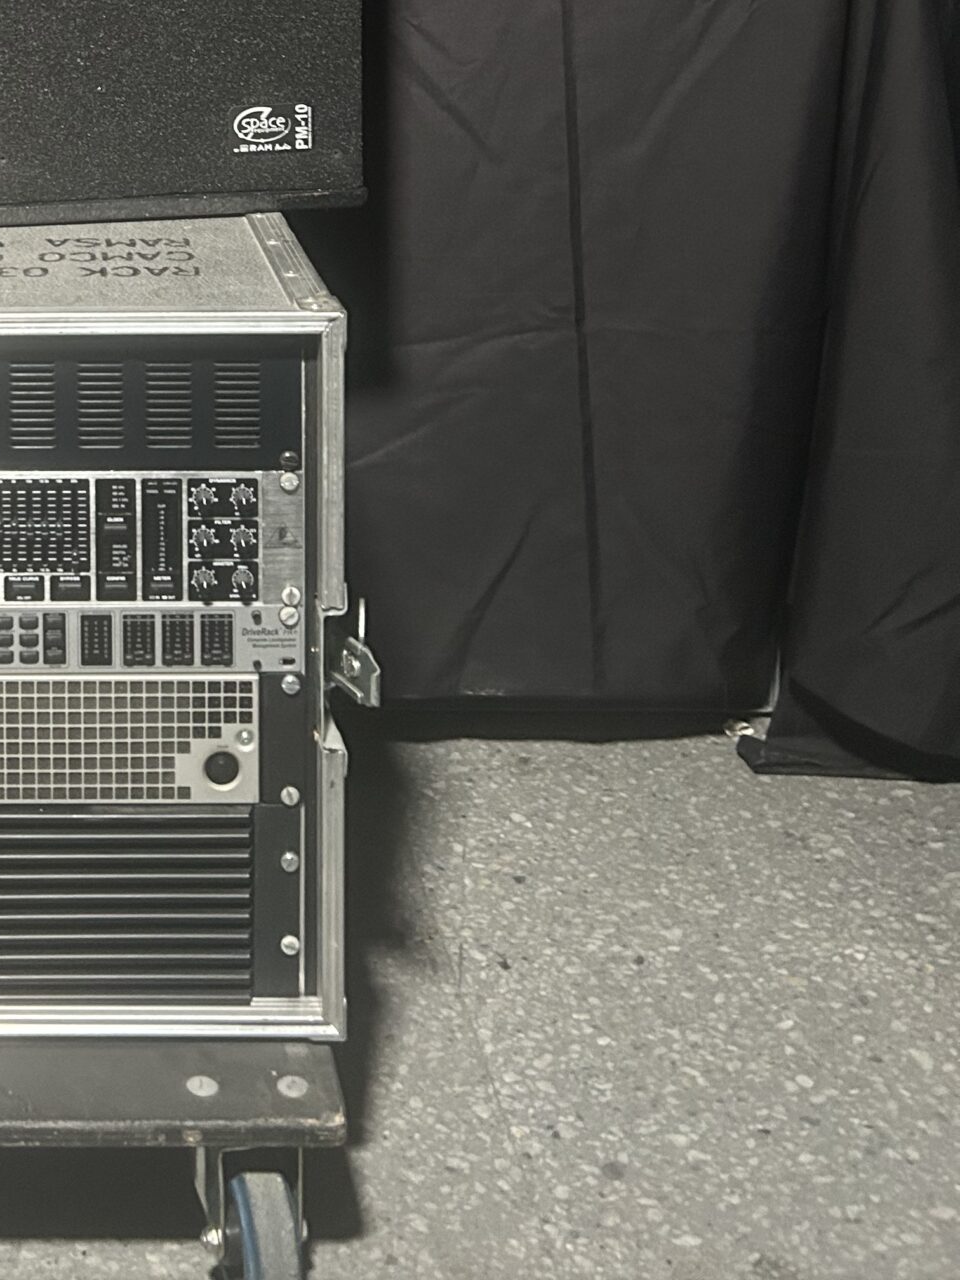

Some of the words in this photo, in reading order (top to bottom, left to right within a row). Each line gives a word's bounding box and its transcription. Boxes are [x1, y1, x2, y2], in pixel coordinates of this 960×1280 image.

[294, 103, 311, 150] PM-10
[45, 238, 190, 248] RAMSA
[38, 251, 195, 263] CAMCO
[79, 265, 200, 277] RACK
